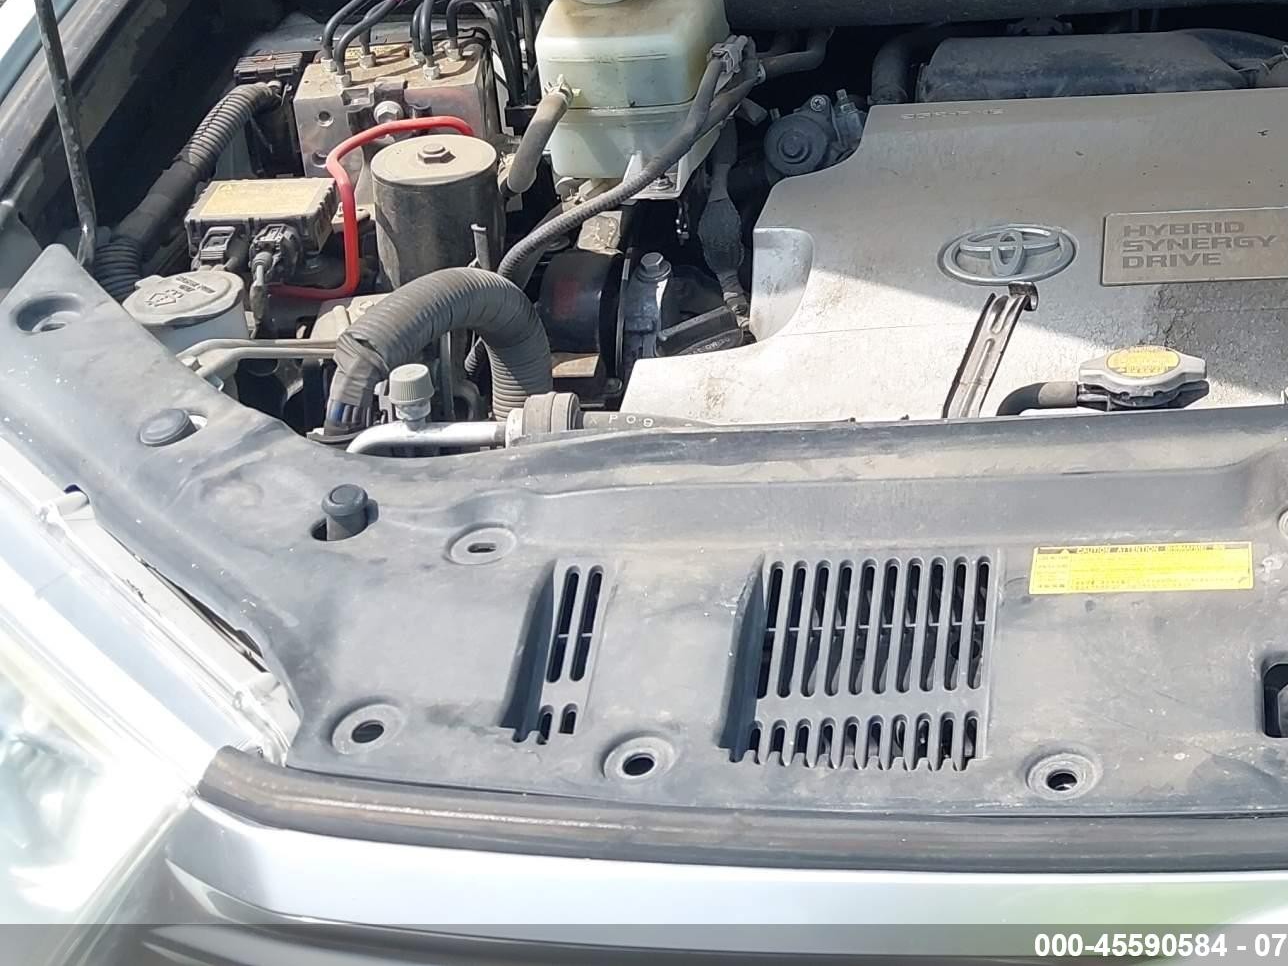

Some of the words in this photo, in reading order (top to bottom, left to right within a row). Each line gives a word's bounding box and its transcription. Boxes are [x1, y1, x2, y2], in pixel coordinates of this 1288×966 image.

[1123, 221, 1245, 237] HYBRID
[1122, 235, 1277, 253] SYNERGY
[1122, 253, 1222, 269] DRIVE
